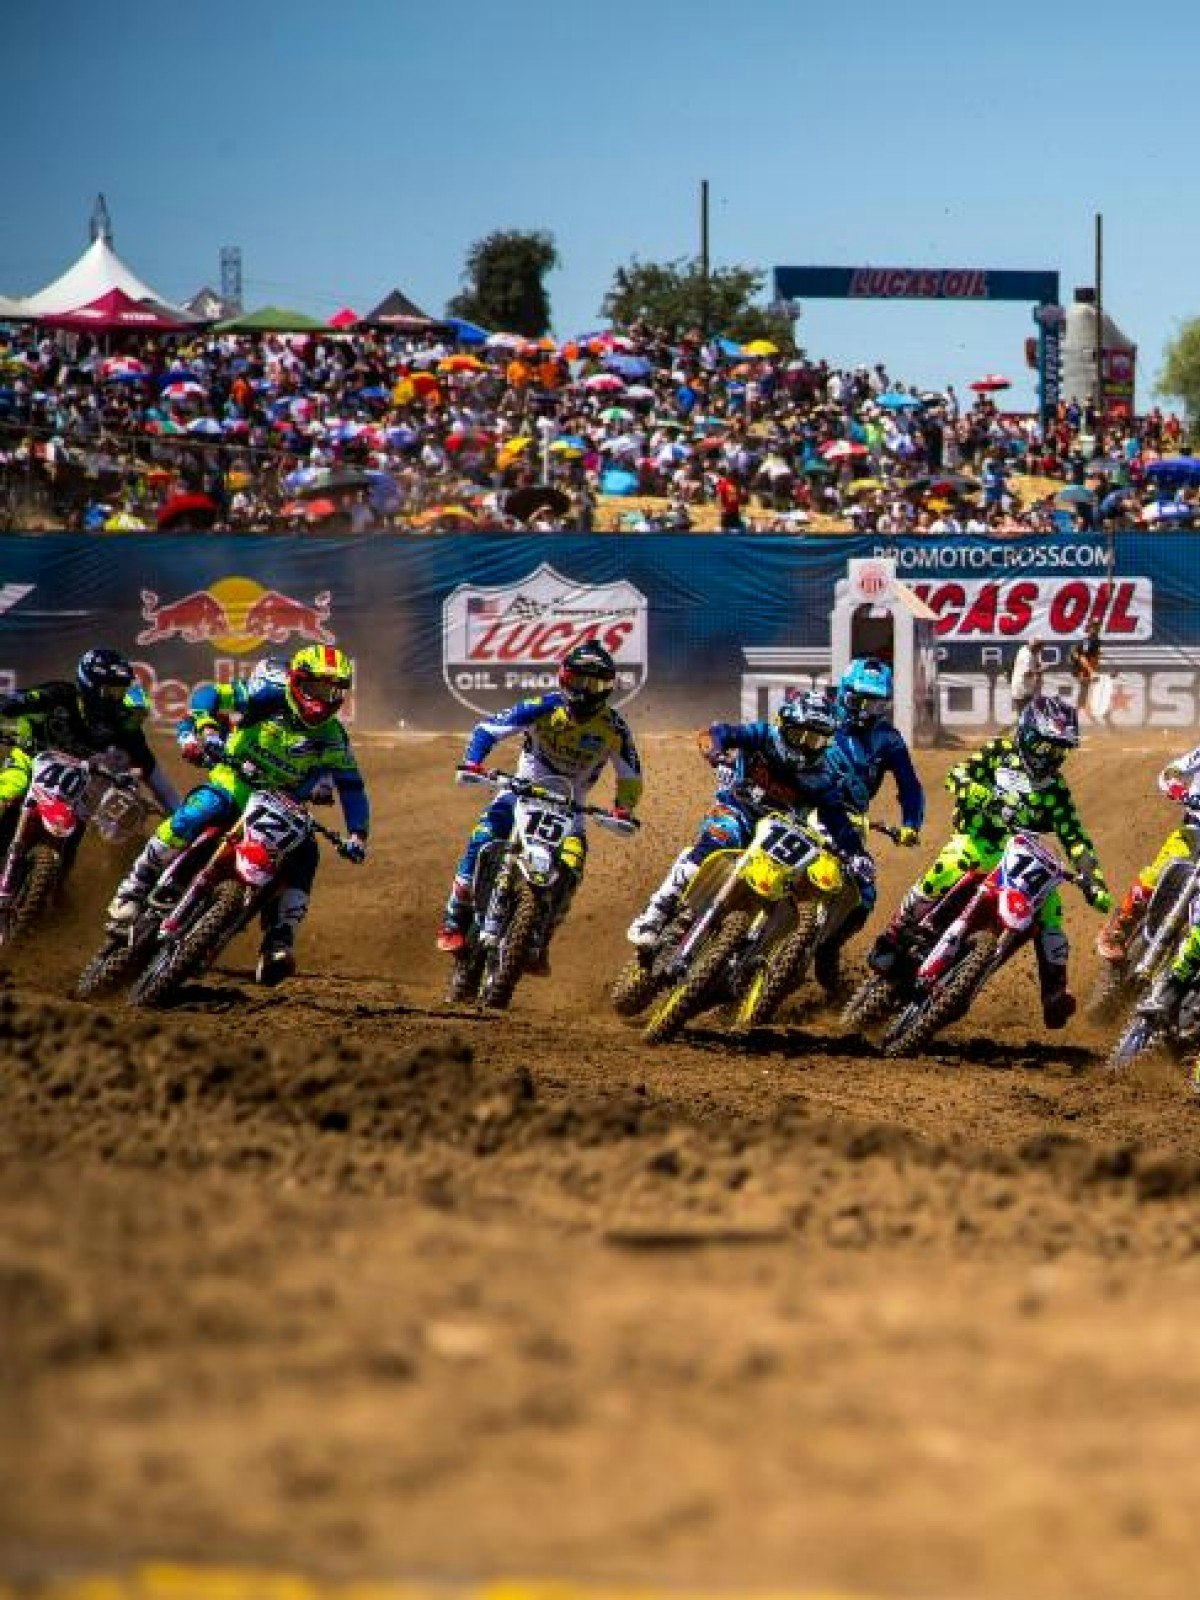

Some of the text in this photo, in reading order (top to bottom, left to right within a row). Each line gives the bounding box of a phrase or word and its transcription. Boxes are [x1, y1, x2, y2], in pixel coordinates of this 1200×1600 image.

[851, 268, 988, 297] LUCAS OIL
[1049, 583, 1139, 634] OIL
[470, 622, 634, 660] LUCAS
[454, 671, 498, 690] OIL
[35, 762, 84, 797] 40
[526, 811, 565, 841] 15
[762, 825, 812, 865] 19
[1006, 853, 1052, 894] 14
